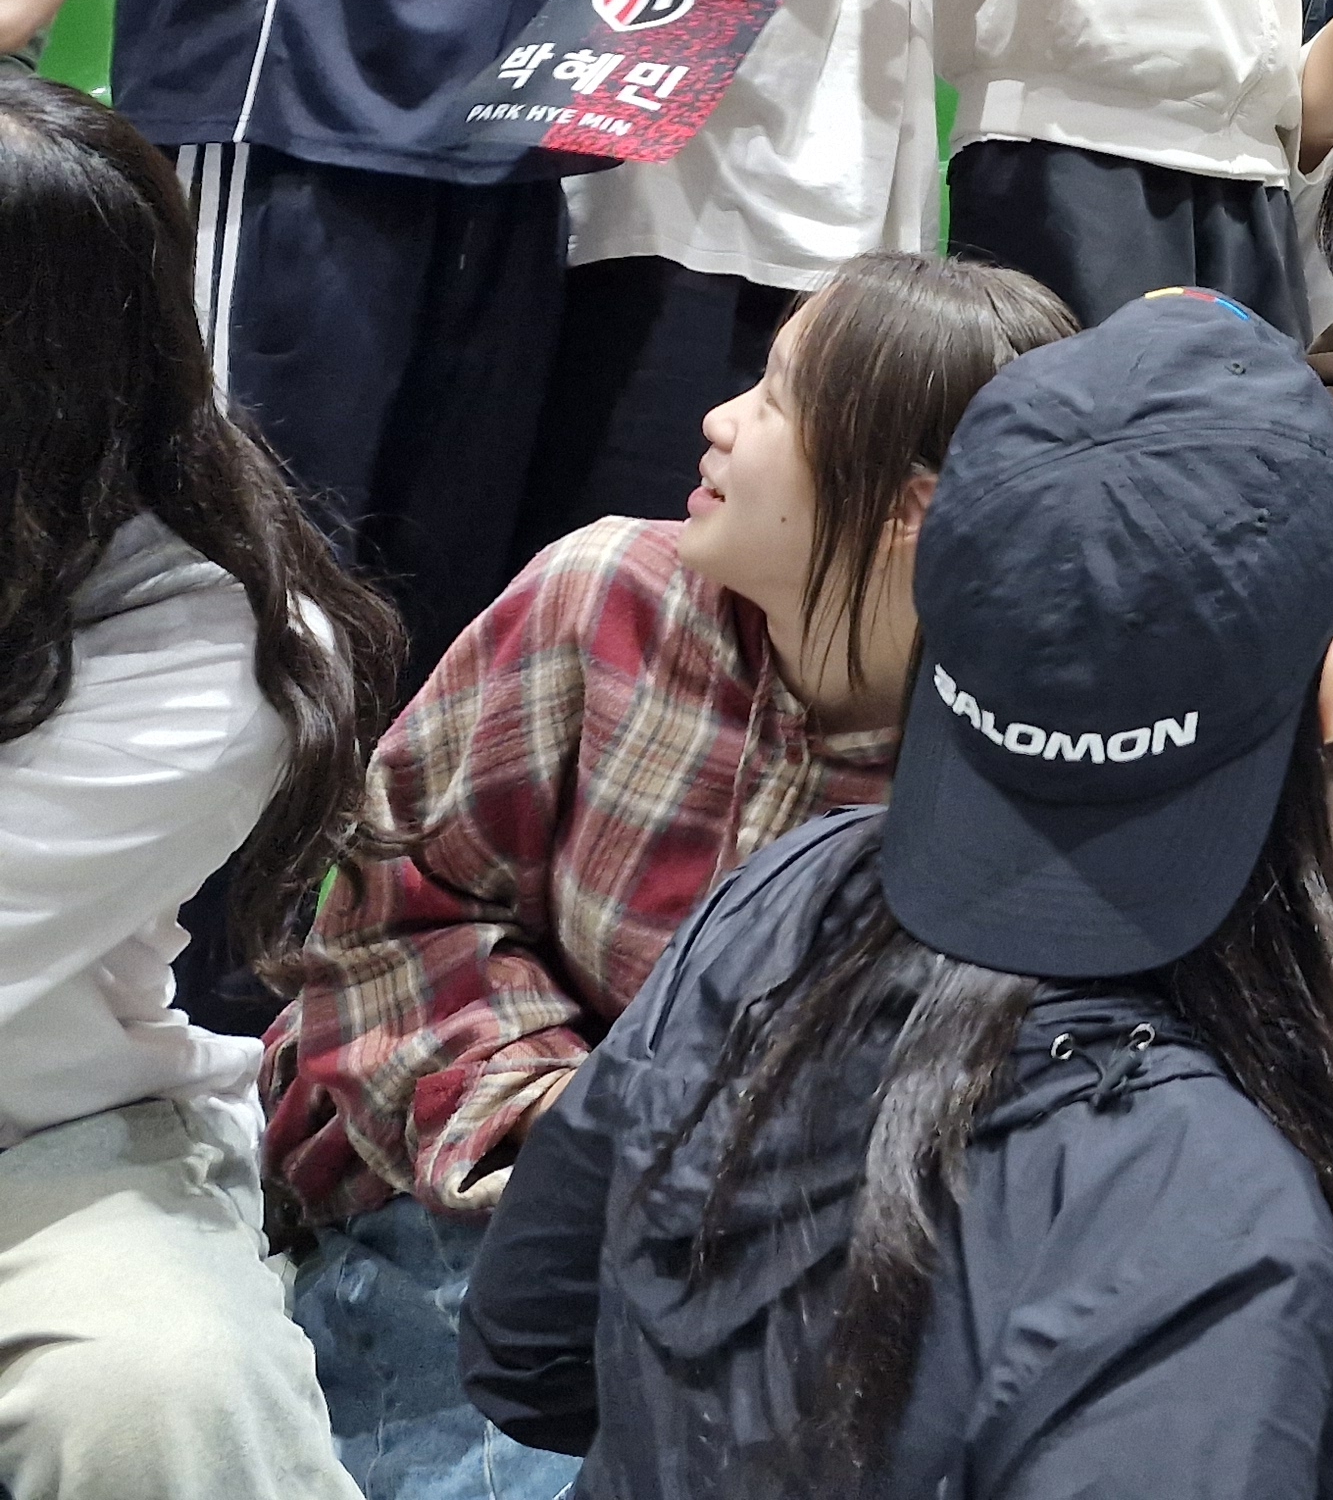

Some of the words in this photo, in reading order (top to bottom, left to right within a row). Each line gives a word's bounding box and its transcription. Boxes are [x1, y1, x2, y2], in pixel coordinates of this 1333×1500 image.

[498, 42, 690, 111] 박혜민
[465, 103, 526, 124] PARK
[525, 104, 579, 125] HYE
[578, 112, 634, 137] MIN
[932, 662, 1200, 765] SALOMON
